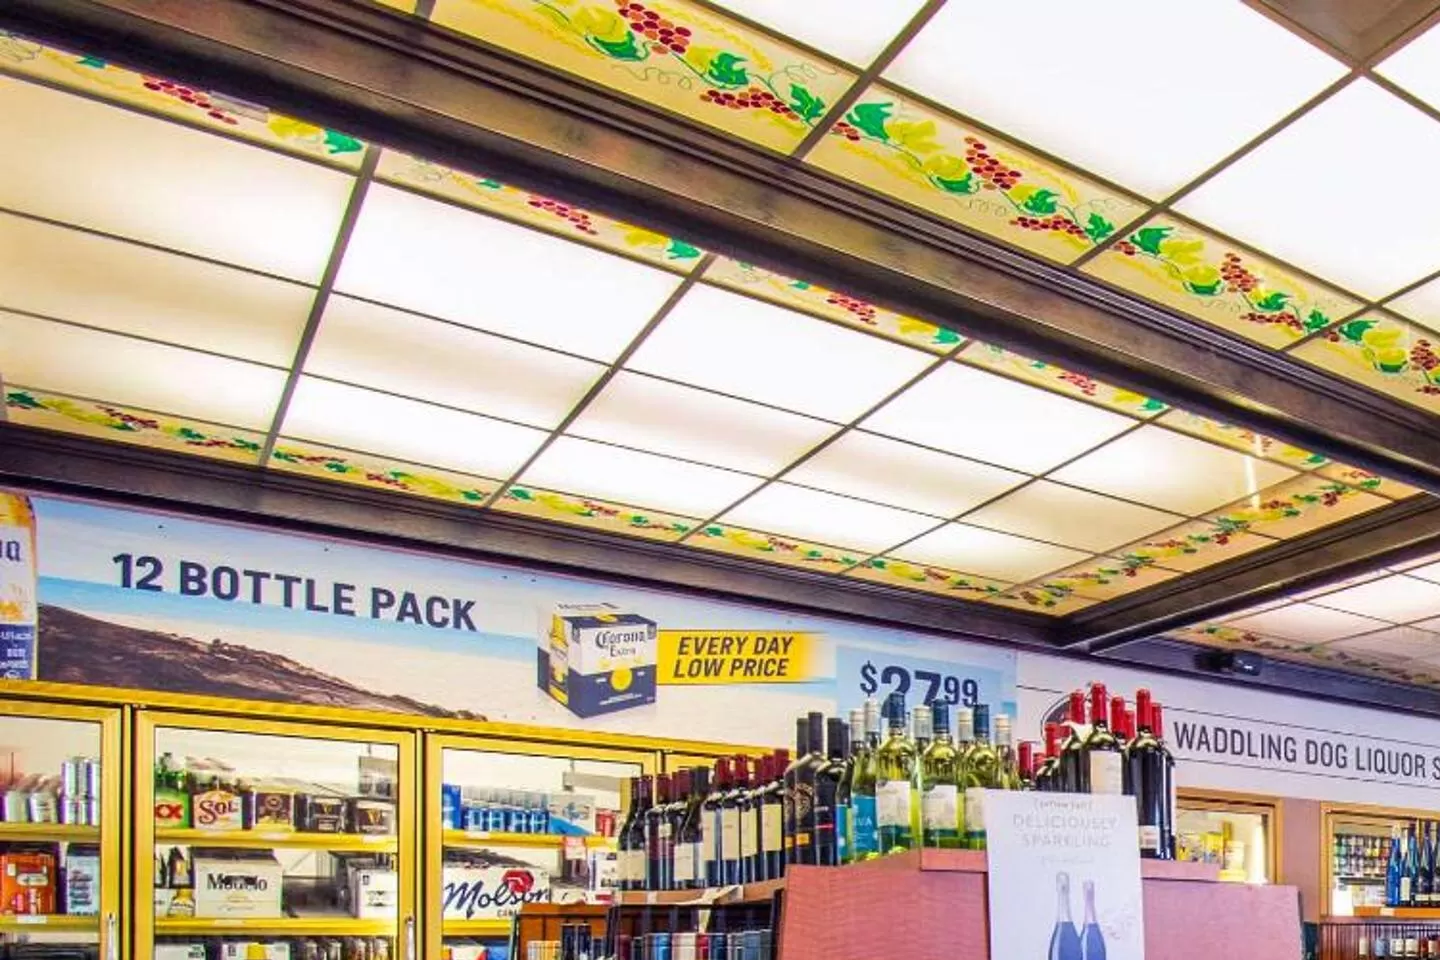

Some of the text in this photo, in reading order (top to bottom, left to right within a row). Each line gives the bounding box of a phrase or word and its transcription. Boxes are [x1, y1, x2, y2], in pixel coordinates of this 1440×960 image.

[113, 553, 478, 632] 12 BOTTLE PACK
[595, 631, 645, 648] Corona
[677, 636, 794, 656] EVERY DAY
[673, 659, 790, 678] LOW PRICE
[1174, 721, 1298, 763] WADDLING
[1305, 739, 1348, 768] DOG
[1355, 748, 1427, 778] LIQUOR
